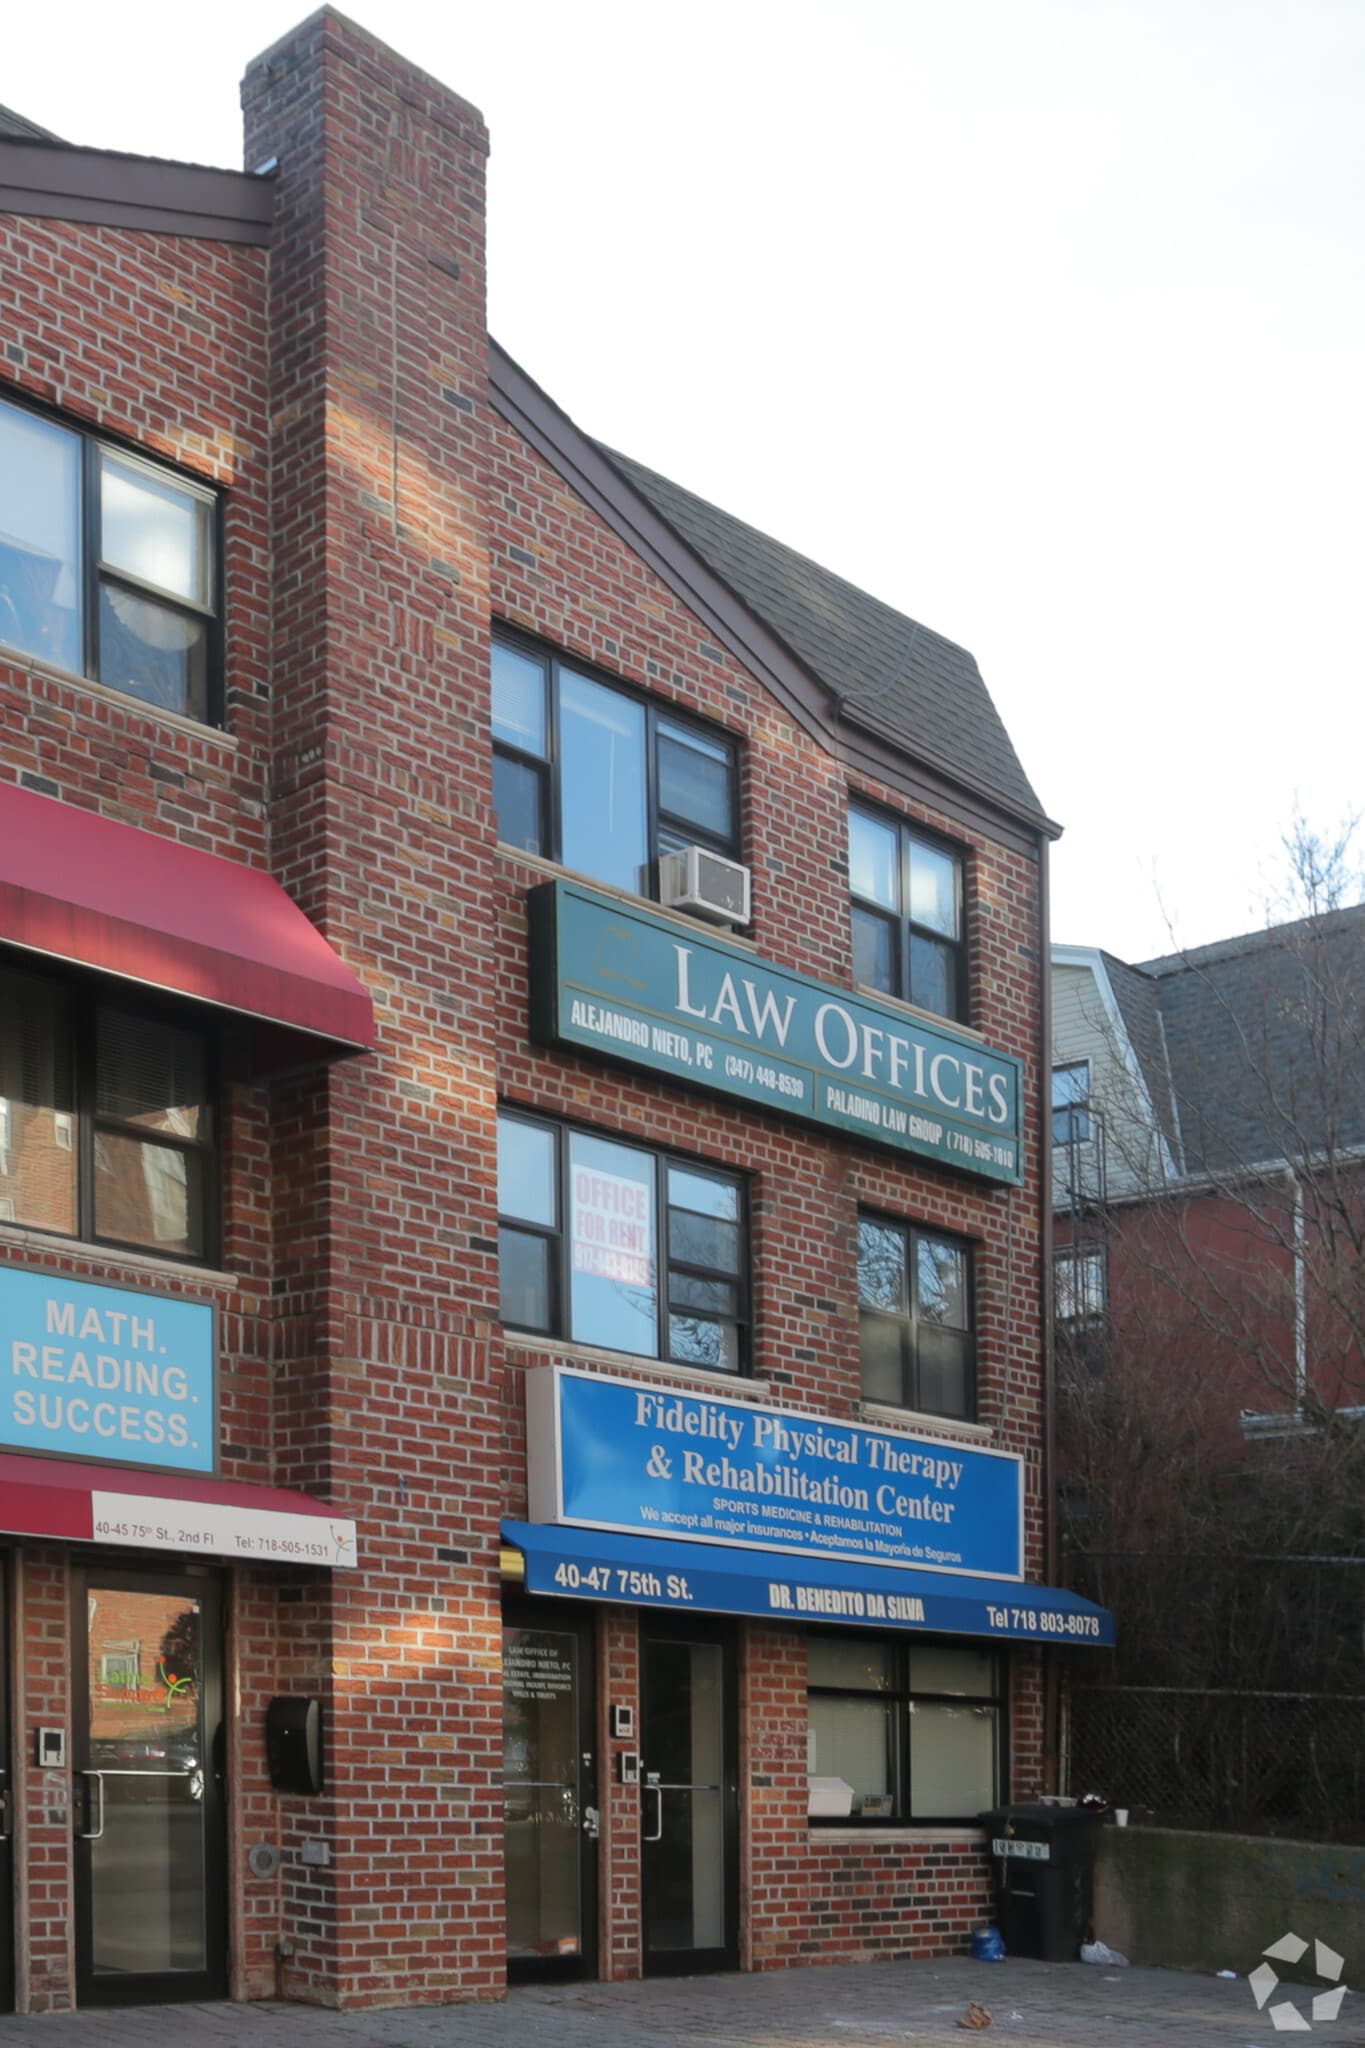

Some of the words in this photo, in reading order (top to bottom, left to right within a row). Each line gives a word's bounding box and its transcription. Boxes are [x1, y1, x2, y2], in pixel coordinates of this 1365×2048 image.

[571, 1000, 649, 1049] ALEJANDRO
[652, 1027, 693, 1066] NIETO,
[696, 1042, 713, 1070] PC
[725, 1055, 754, 1084] (347)
[672, 943, 798, 1047] LAW
[814, 1003, 1008, 1124] OFFICES
[827, 1086, 880, 1125] PALADINO
[882, 1105, 908, 1134] LAW
[909, 1114, 943, 1145] GROUP
[575, 1173, 647, 1220] OFFICE
[575, 1209, 606, 1243] FOR
[609, 1220, 647, 1253] RENT
[46, 1299, 167, 1354] MATH.
[11, 1340, 199, 1403] READING.
[12, 1389, 199, 1449] SUCCESS.
[634, 1392, 744, 1450] Fidelity
[752, 1416, 858, 1465] Physical
[866, 1438, 964, 1490] Therapy
[646, 1445, 673, 1480] &
[682, 1450, 869, 1512] Rehabilitation
[876, 1485, 955, 1524] Center
[95, 1521, 128, 1536] 40-45
[178, 1530, 200, 1544] 2nd
[234, 1535, 254, 1549] Tel:
[258, 1538, 329, 1557] 718-505-1531
[640, 1505, 660, 1520] We
[661, 1510, 699, 1528] accept
[700, 1514, 713, 1528] all
[715, 1517, 746, 1534] major
[747, 1520, 804, 1541] insurances
[810, 1529, 864, 1549] Aceptamos
[865, 1537, 874, 1550] la
[911, 1544, 923, 1557] de
[925, 1546, 962, 1565] Seguros
[712, 1497, 759, 1517] SPORTS
[761, 1504, 812, 1524] MEDICINE
[815, 1513, 822, 1526] &
[823, 1515, 903, 1537] REHABILITATION
[554, 1562, 611, 1590] 40-47
[616, 1570, 661, 1597] 75th
[666, 1574, 693, 1600] St.
[769, 1583, 794, 1609] DR.
[797, 1586, 864, 1617] BENEDITO
[867, 1596, 887, 1619] DA
[888, 1597, 925, 1622] SILVA
[987, 1606, 1009, 1629] Tel
[1012, 1609, 1037, 1631] 718
[1040, 1612, 1099, 1637] 803-8078
